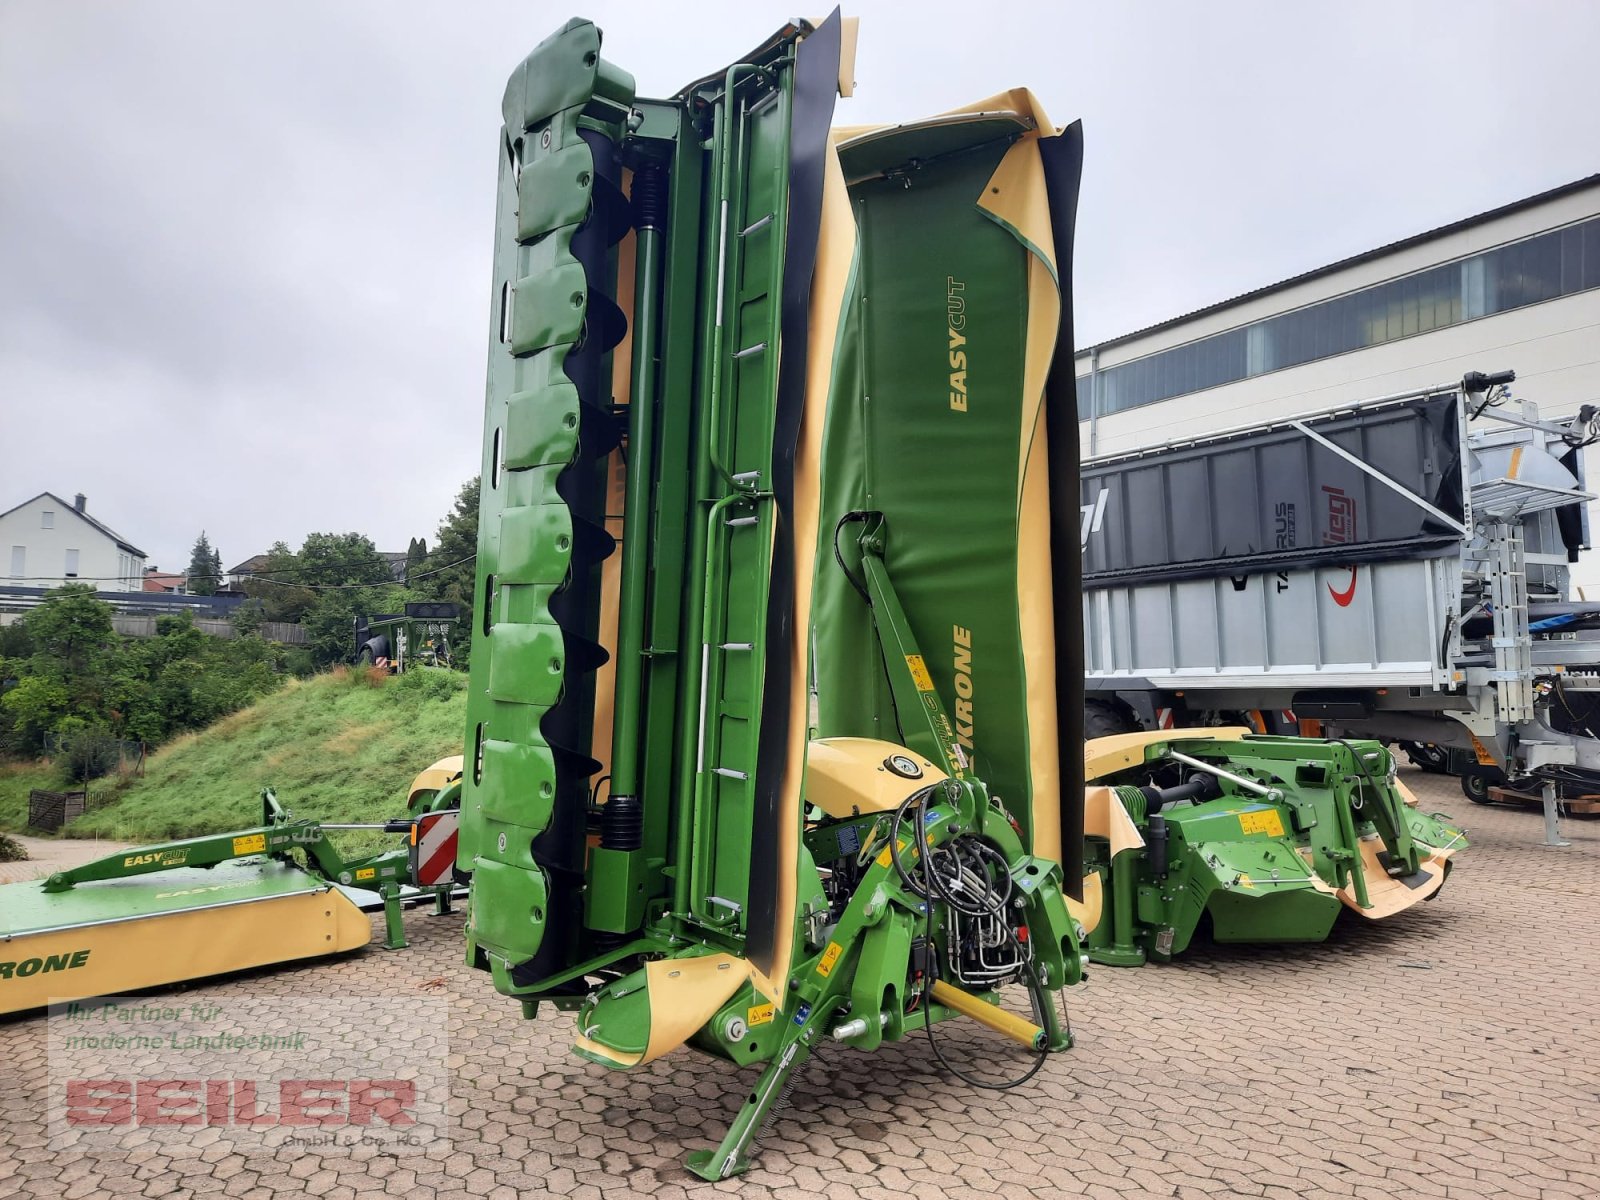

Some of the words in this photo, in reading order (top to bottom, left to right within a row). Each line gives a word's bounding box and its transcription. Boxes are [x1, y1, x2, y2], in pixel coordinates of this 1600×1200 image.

[948, 276, 967, 412] EASYCUT
[1275, 501, 1289, 594] TARUS
[953, 624, 974, 750] KRONE
[123, 848, 191, 868] EASYCUT
[0, 949, 91, 980] RONE
